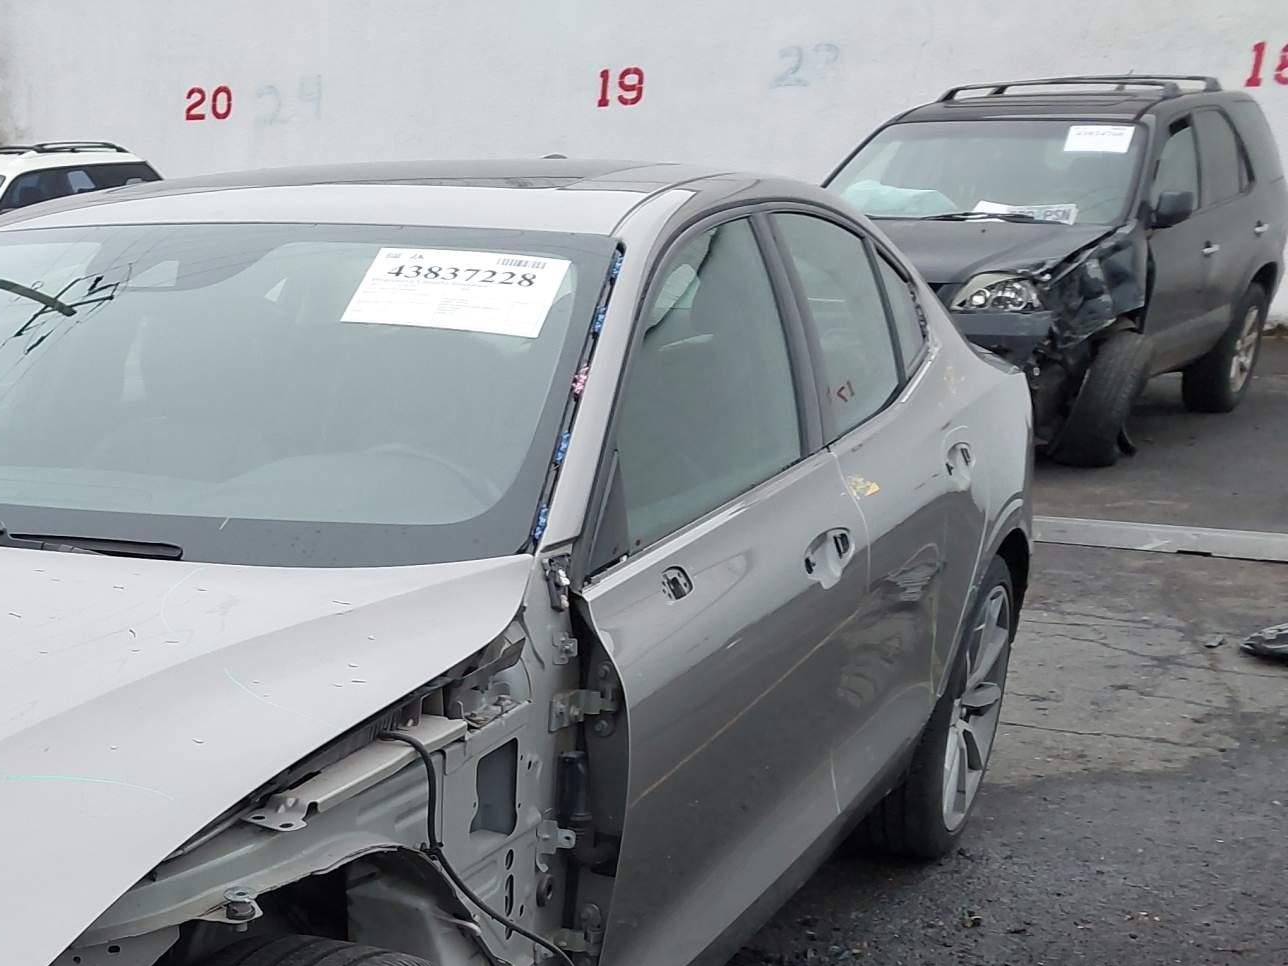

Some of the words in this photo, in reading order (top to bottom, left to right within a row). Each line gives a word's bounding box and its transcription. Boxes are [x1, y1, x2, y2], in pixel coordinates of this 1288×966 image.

[185, 84, 232, 122] 20
[596, 67, 644, 108] 19
[387, 263, 537, 288] 43837228
